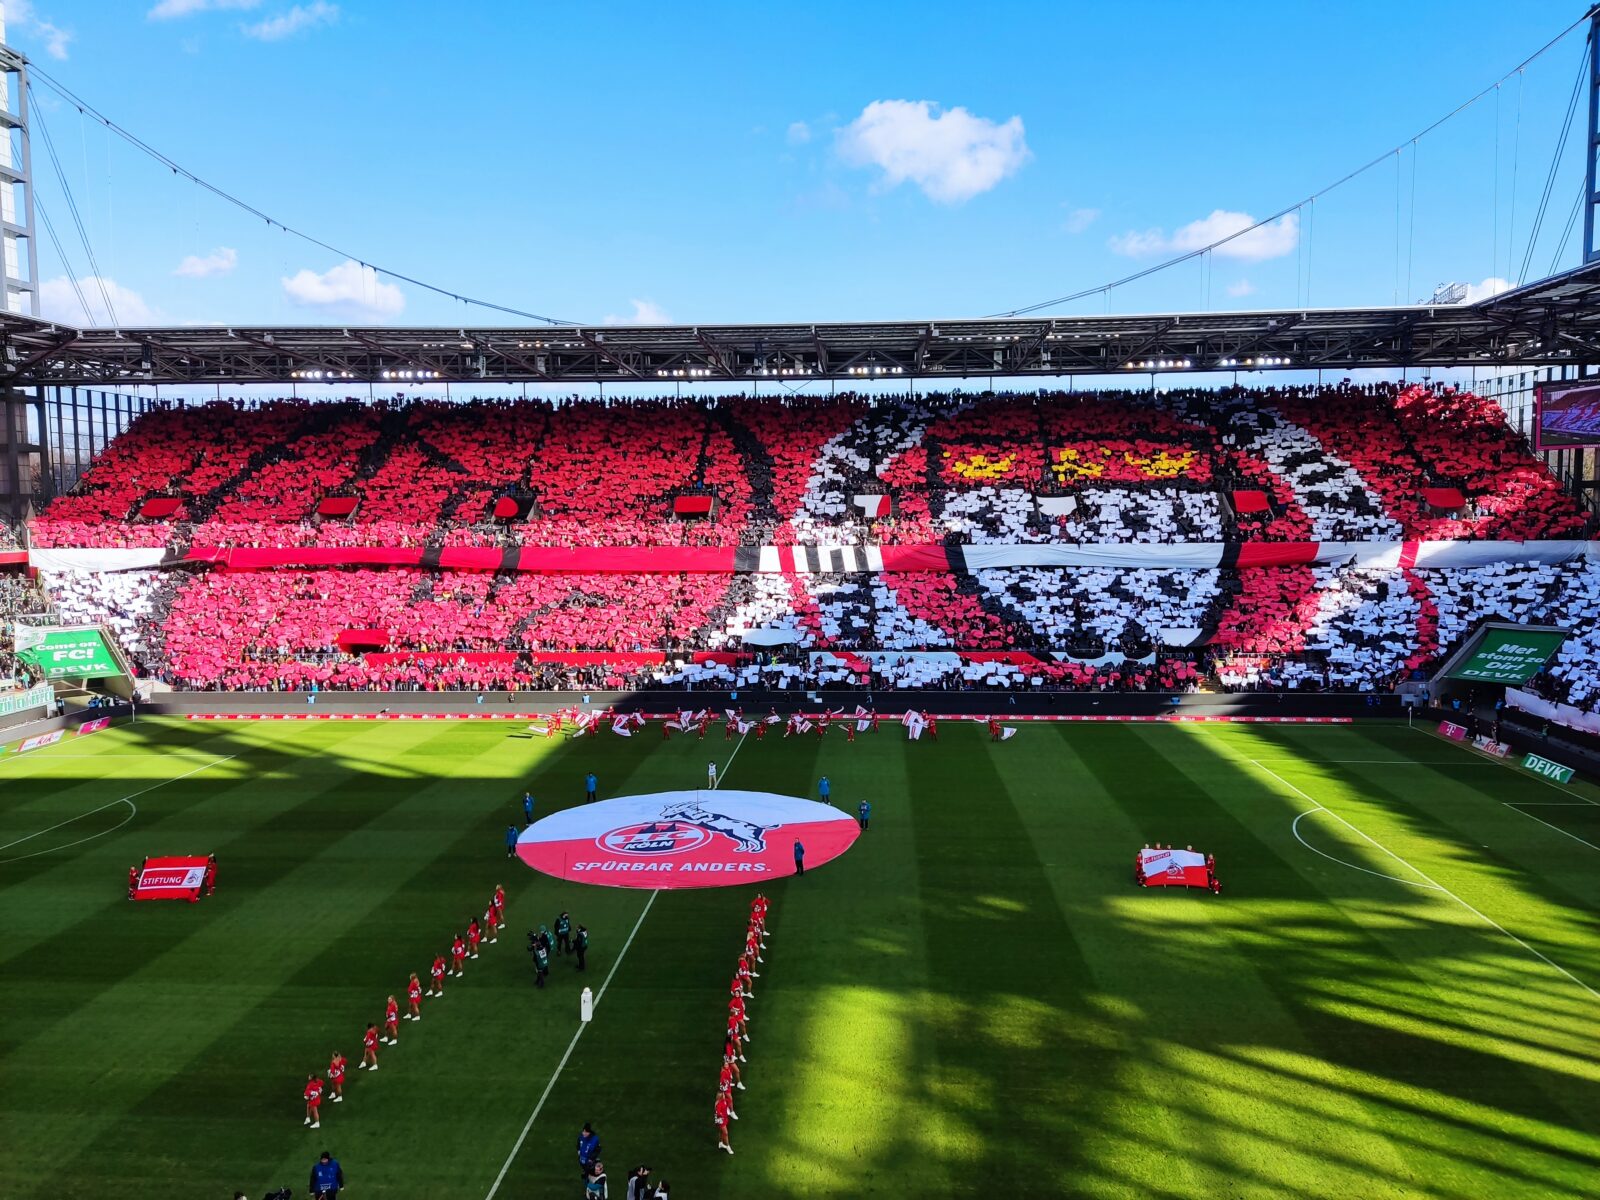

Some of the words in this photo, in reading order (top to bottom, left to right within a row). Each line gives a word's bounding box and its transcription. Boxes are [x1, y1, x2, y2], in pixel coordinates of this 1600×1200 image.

[36, 643, 76, 651] Come
[1496, 643, 1538, 655] Mer
[53, 648, 94, 661] FC!
[1476, 652, 1525, 662] stonn
[50, 664, 109, 674] DEVK
[1484, 661, 1527, 671] Dir!
[1463, 670, 1525, 679] DEVK
[1525, 757, 1565, 780] DEVK
[648, 831, 688, 840] FC
[624, 840, 674, 850] KÖLN
[572, 861, 673, 871] SPÜRBAR
[679, 862, 772, 872] ANDERS.
[142, 876, 183, 885] STIFTUNG
